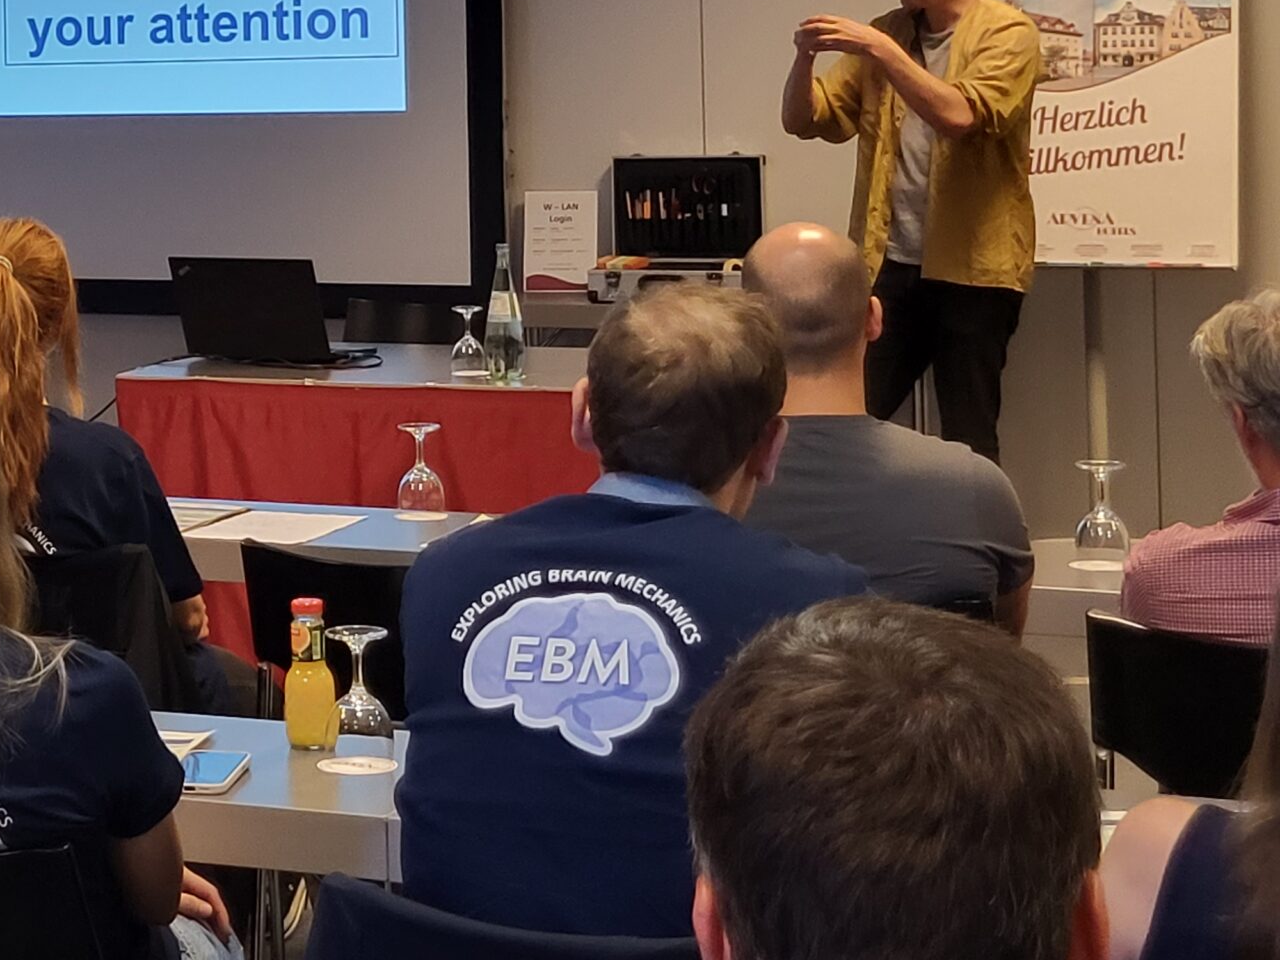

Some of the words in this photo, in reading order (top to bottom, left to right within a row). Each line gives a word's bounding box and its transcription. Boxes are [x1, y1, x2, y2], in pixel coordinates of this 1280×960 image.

[27, 13, 134, 58] your
[149, 0, 370, 44] attention
[1033, 97, 1148, 135] Herzlich
[1028, 132, 1187, 176] illkommen!
[549, 215, 573, 224] Login
[561, 203, 579, 211] LAN
[451, 570, 542, 642] EXPLORING
[548, 569, 613, 584] BRAIN
[614, 572, 702, 645] MECHANICS
[505, 636, 630, 686] EBM
